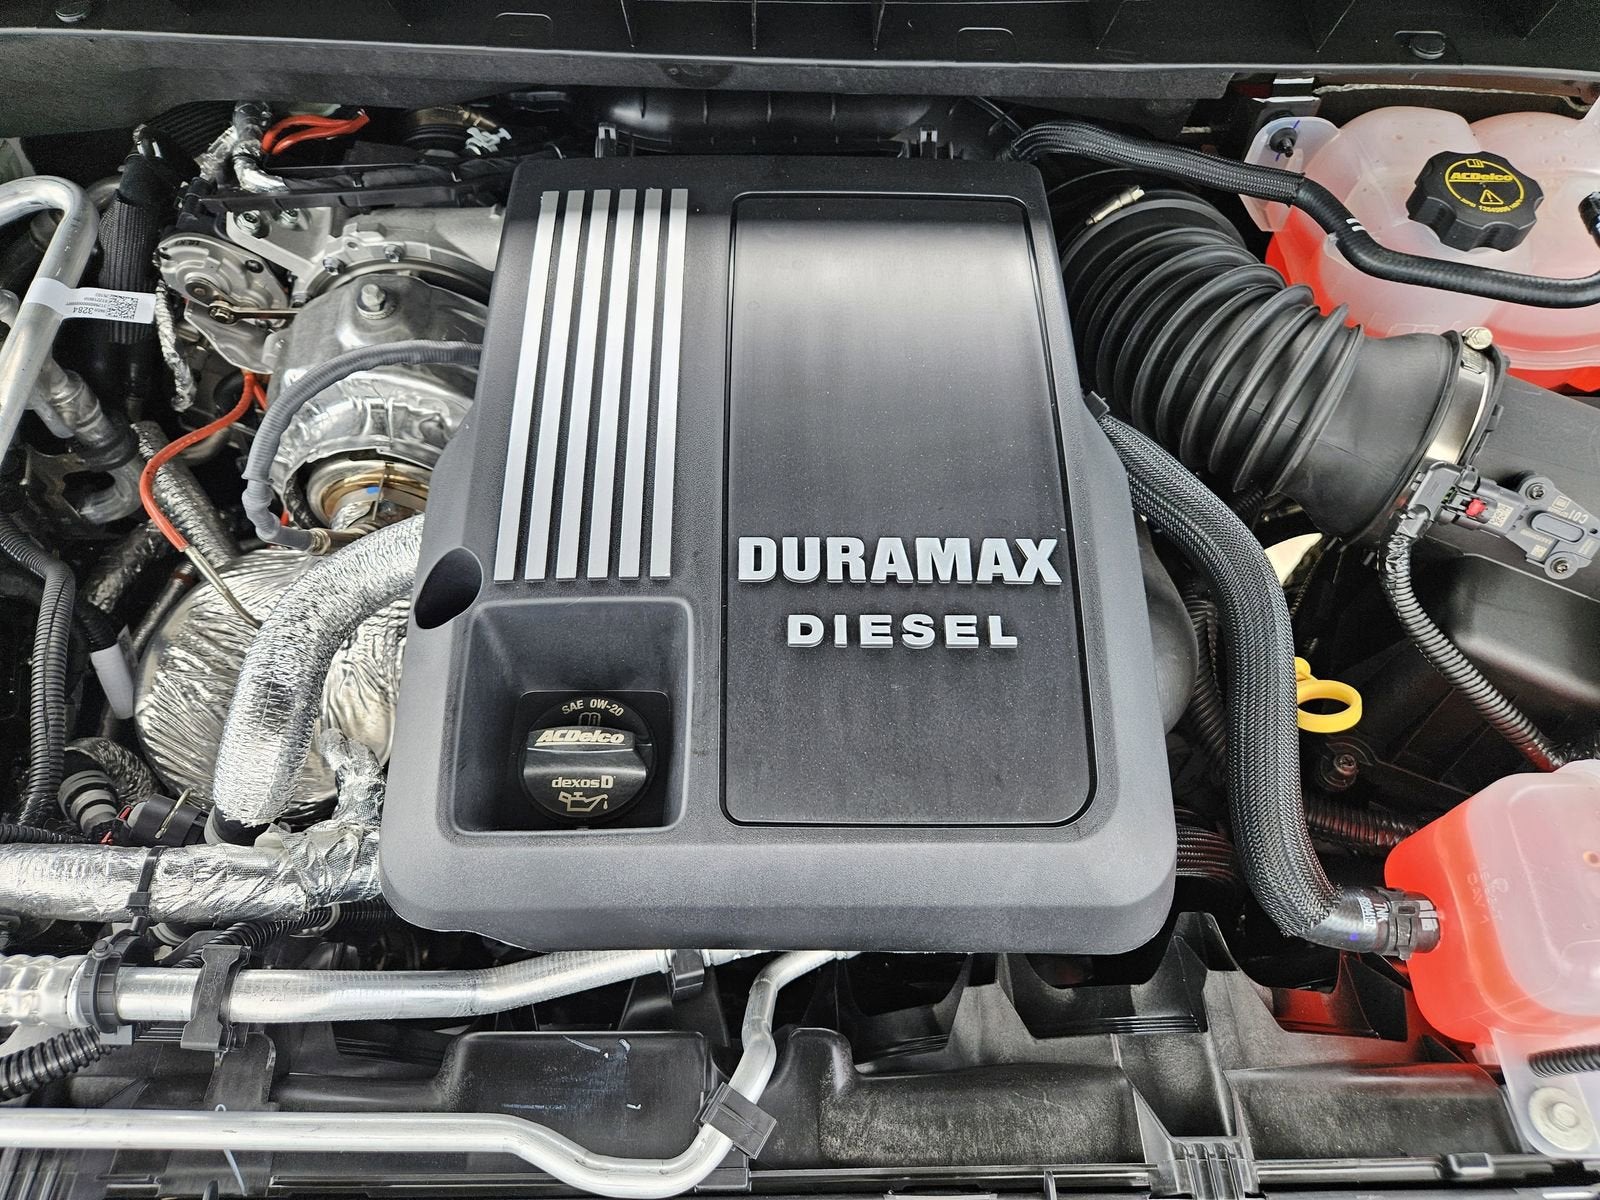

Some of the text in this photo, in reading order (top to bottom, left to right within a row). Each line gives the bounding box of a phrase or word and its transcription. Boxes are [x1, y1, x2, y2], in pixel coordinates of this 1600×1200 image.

[1450, 172, 1514, 182] ACDelco
[72, 306, 94, 315] 3284
[737, 536, 1062, 585] DURAMAX
[787, 613, 1018, 649] DIESEL
[561, 698, 625, 717] SAE 0W-20
[535, 729, 625, 744] ACDelco
